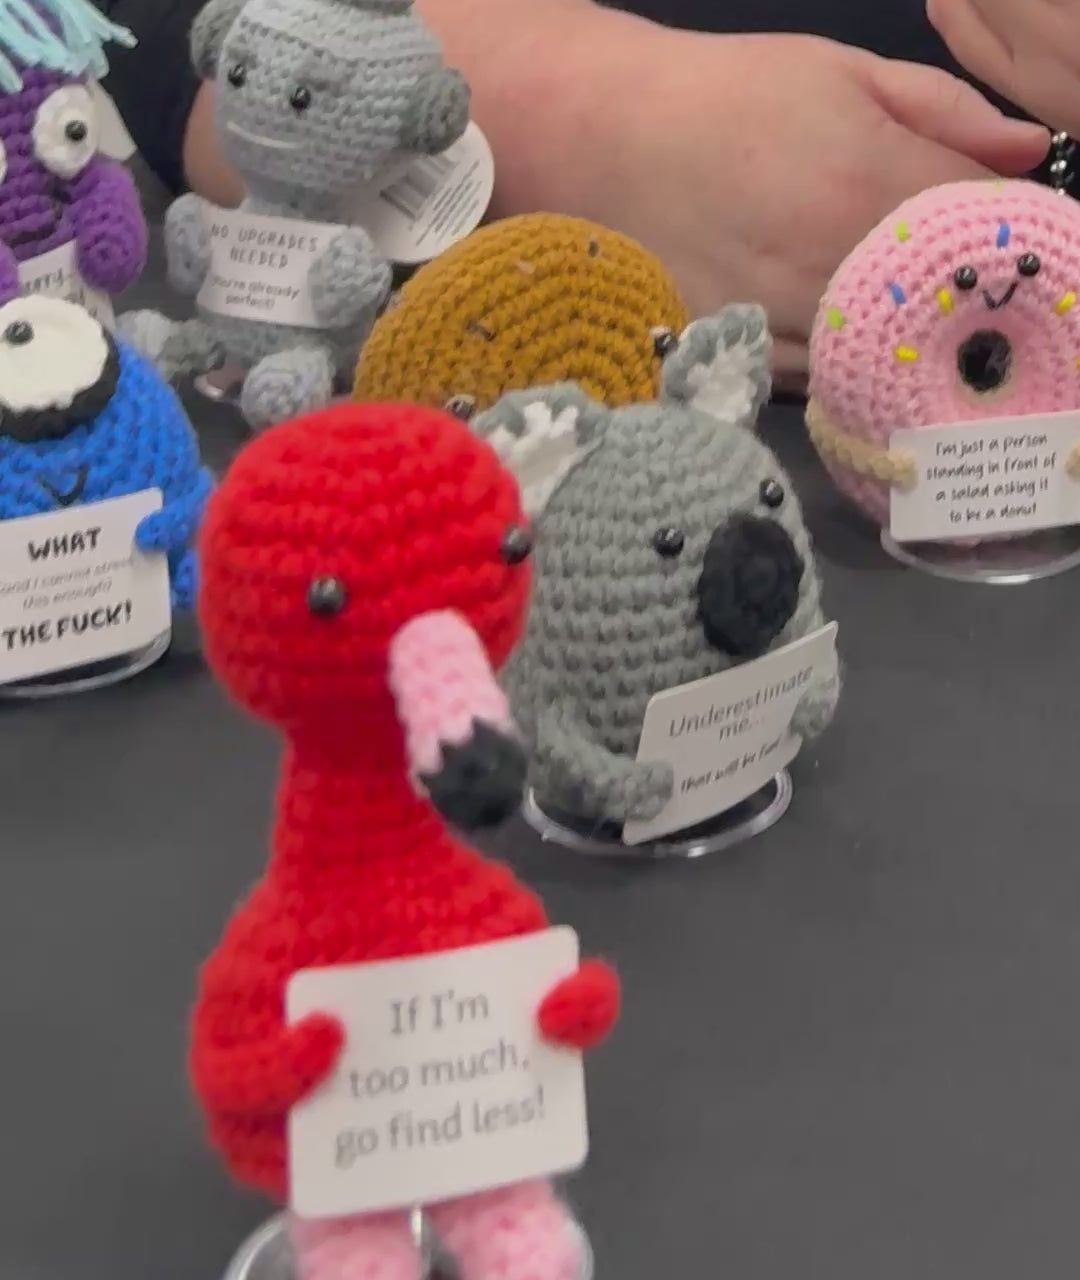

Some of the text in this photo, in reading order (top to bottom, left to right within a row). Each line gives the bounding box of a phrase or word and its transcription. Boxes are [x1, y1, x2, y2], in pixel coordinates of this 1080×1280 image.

[238, 227, 319, 253] UPGRADES
[230, 246, 289, 269] NEEDED
[957, 438, 984, 459] just
[988, 438, 999, 451] a
[1003, 433, 1048, 453] person
[926, 450, 1057, 481] standing in front of
[935, 475, 1049, 502] a salad asking it
[949, 501, 1037, 524] to be a donut
[27, 526, 103, 563] WHAT
[2, 597, 133, 652] THE FUCK!
[669, 665, 814, 738] Underestimate
[680, 768, 713, 793] that
[389, 988, 490, 1036] If I'm
[350, 1064, 410, 1099] too
[334, 1083, 545, 1170] go find less!
